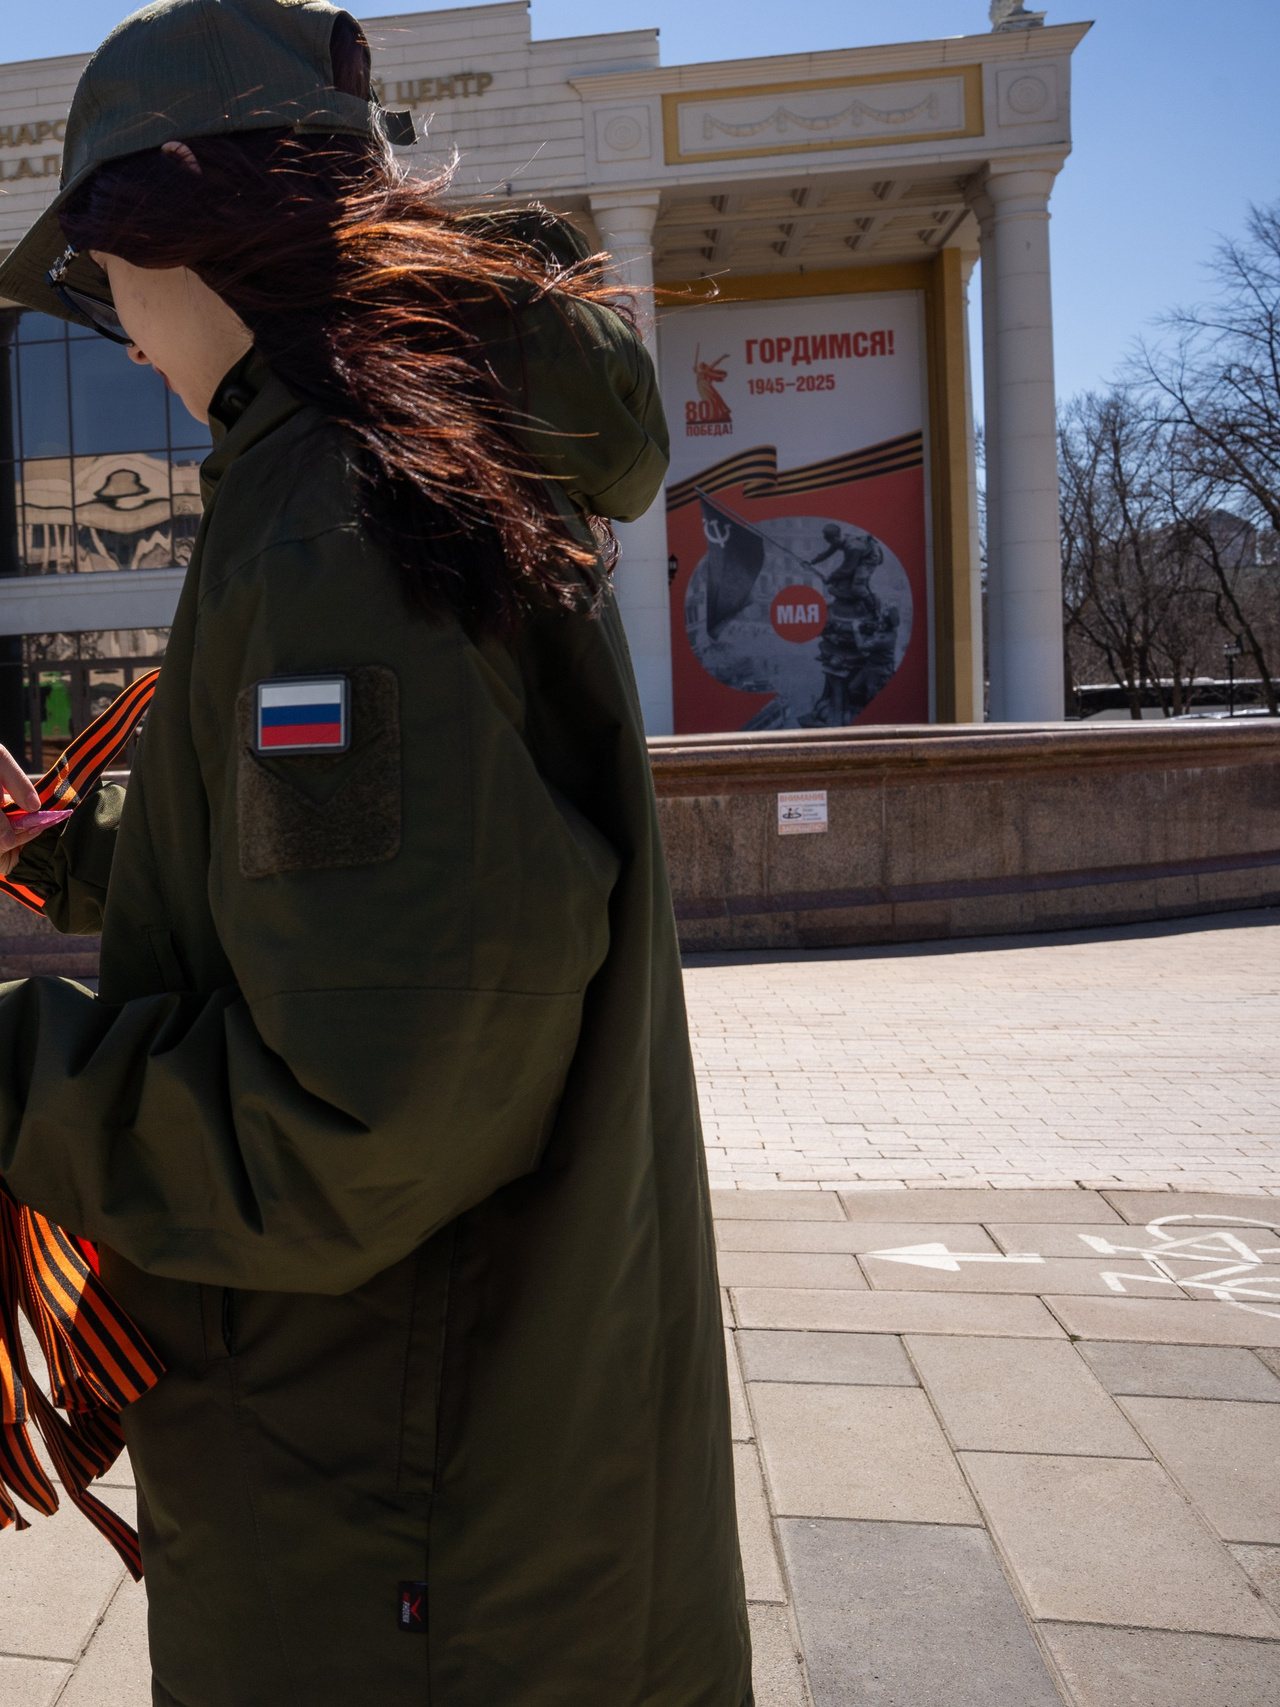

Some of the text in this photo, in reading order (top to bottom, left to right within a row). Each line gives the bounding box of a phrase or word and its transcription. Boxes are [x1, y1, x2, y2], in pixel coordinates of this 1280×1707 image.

[396, 72, 494, 110] ЦЕНТР
[745, 330, 895, 366] ГОРДИМСЯ!
[685, 400, 710, 422] 80
[686, 423, 733, 437] ПОБЕДА!
[776, 604, 819, 624] МАЯ
